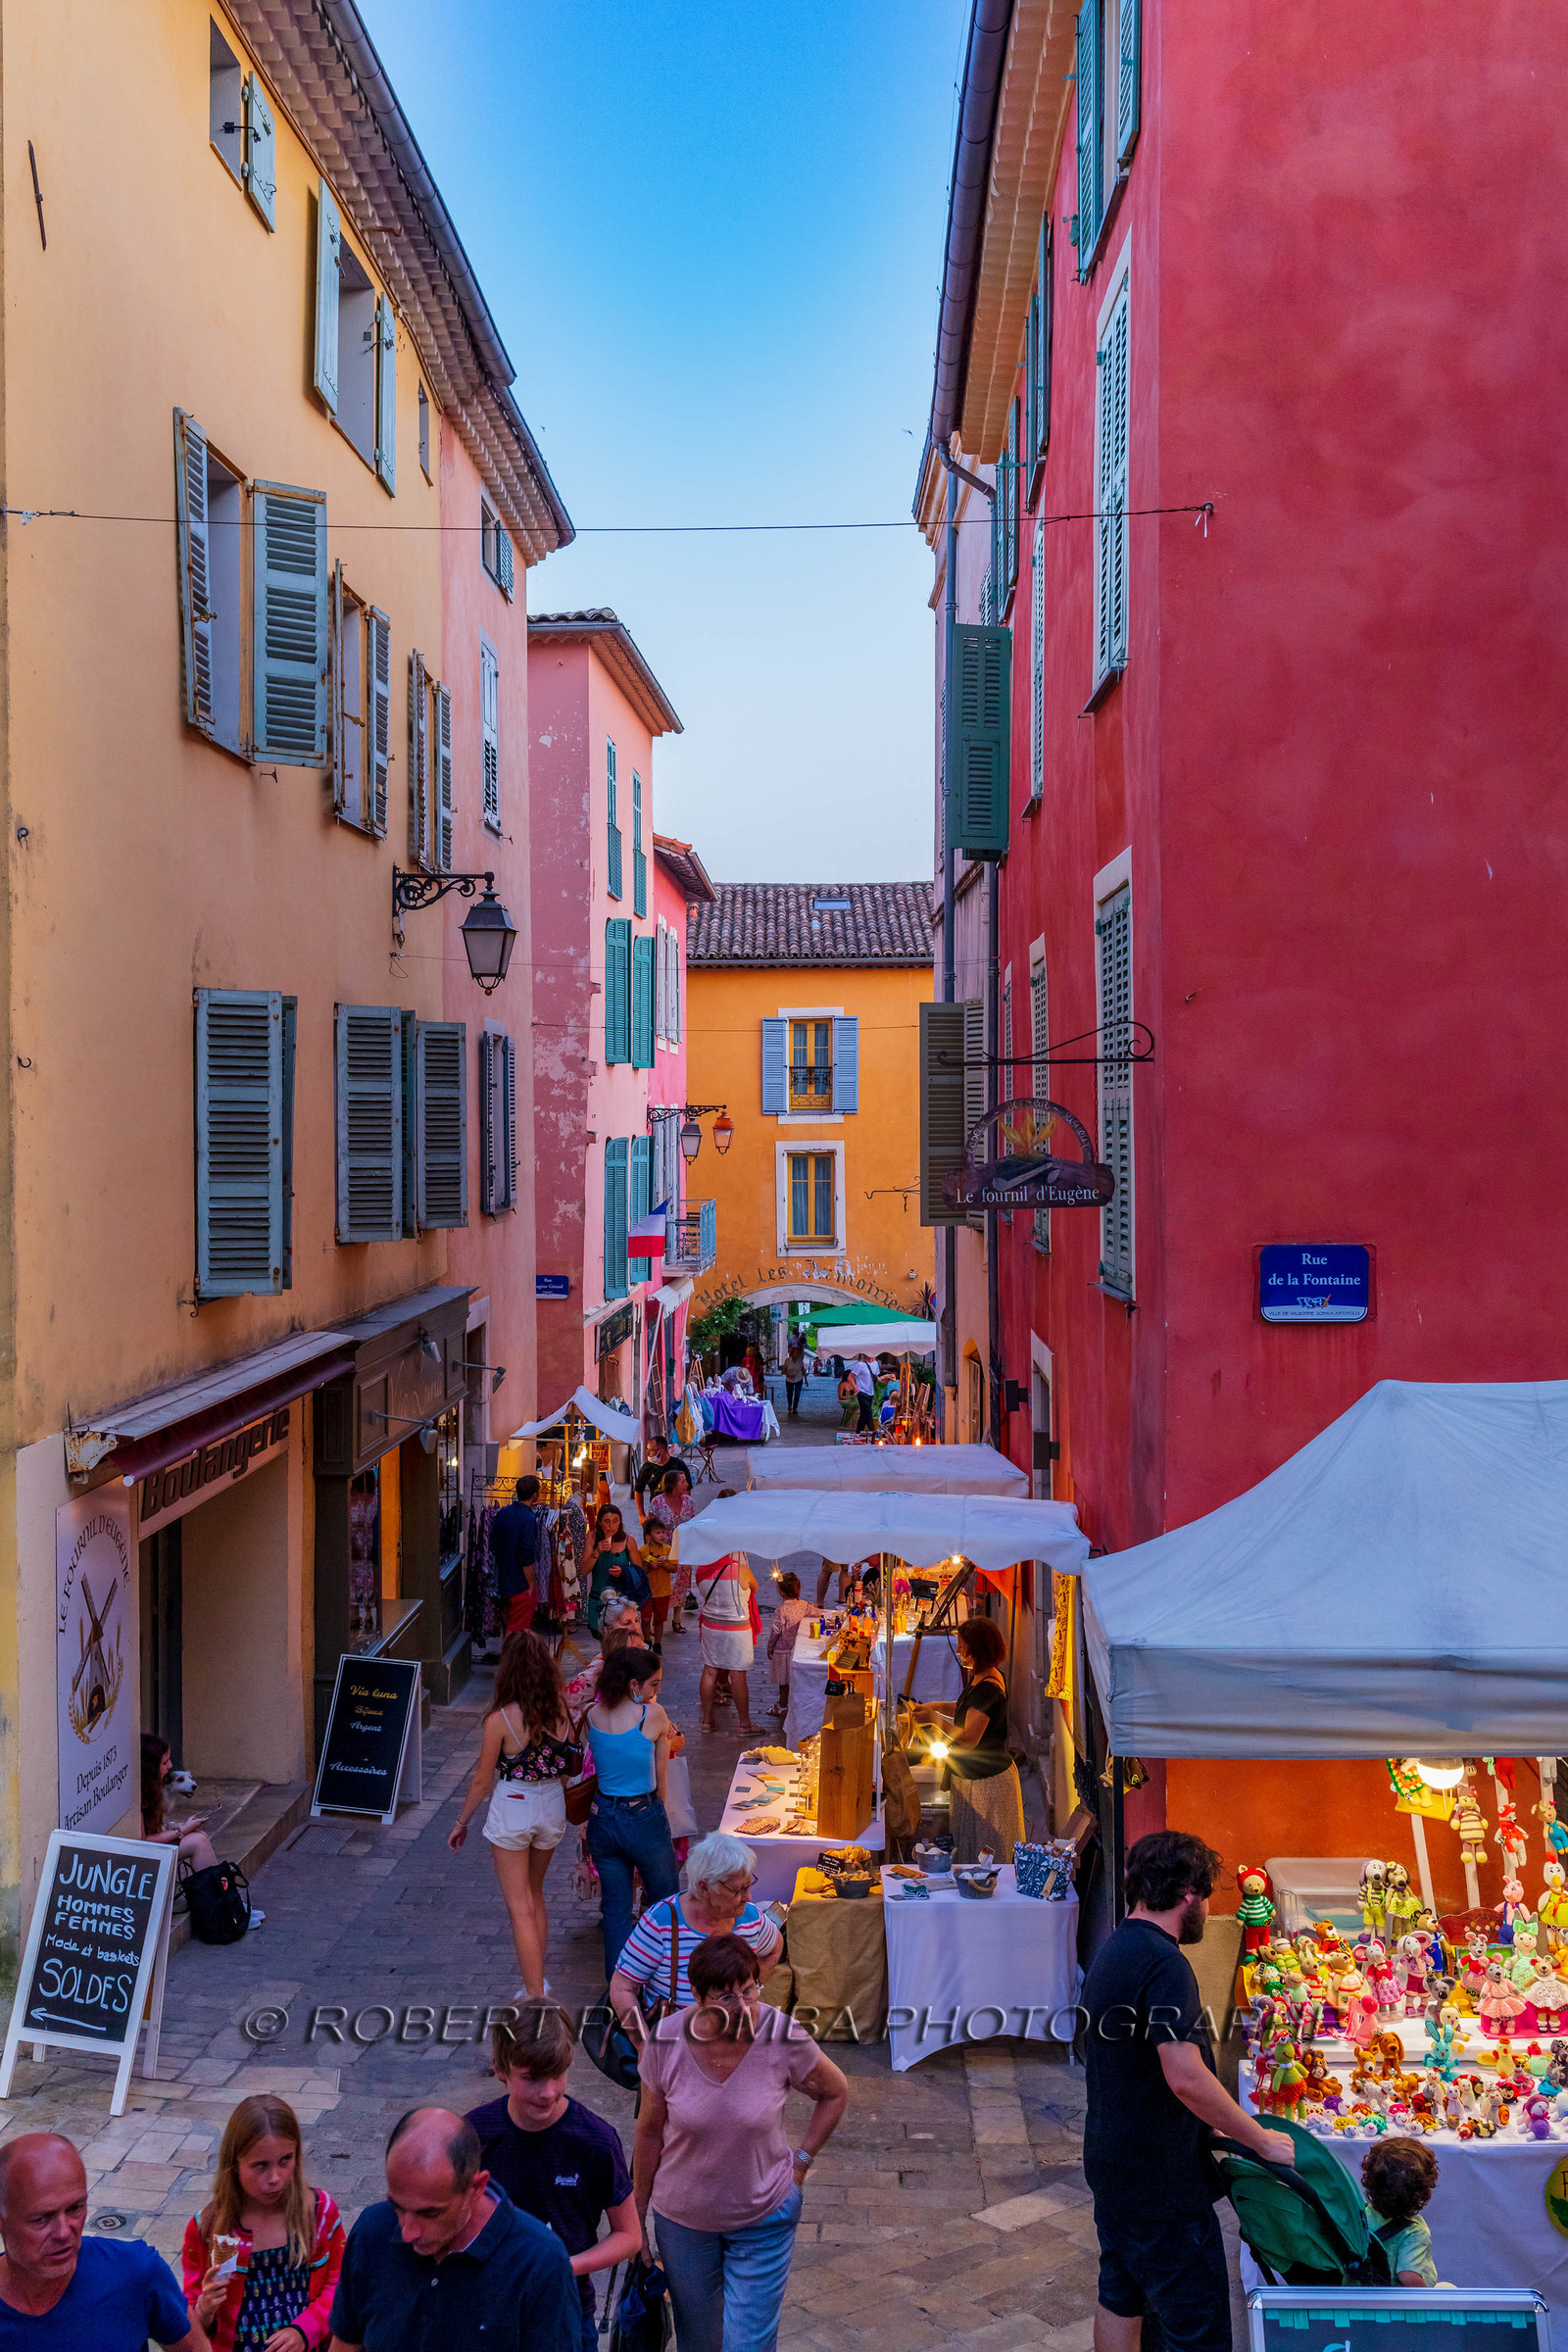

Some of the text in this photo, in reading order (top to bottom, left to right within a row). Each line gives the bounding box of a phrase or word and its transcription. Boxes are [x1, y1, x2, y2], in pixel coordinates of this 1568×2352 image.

[956, 1185, 1100, 1206] Le fournil d'Eugène
[1301, 1252, 1328, 1265] Rue
[695, 1274, 748, 1305] Hôtel
[1268, 1273, 1361, 1286] de la Fontaine
[140, 1407, 290, 1522] Boulangerie
[350, 1685, 369, 1696] Via
[350, 1721, 382, 1733] Argent
[76, 1745, 117, 1795] Depuis 1873
[329, 1762, 388, 1776] Accessoires
[64, 1764, 128, 1831] Artisan Boulanger
[59, 1854, 154, 1900] JUNGLE
[57, 1894, 135, 1924] HOMMES
[54, 1912, 136, 1940] FEMMES
[45, 1934, 141, 1967] Mode et baskets
[39, 1958, 132, 2013] SOLDES
